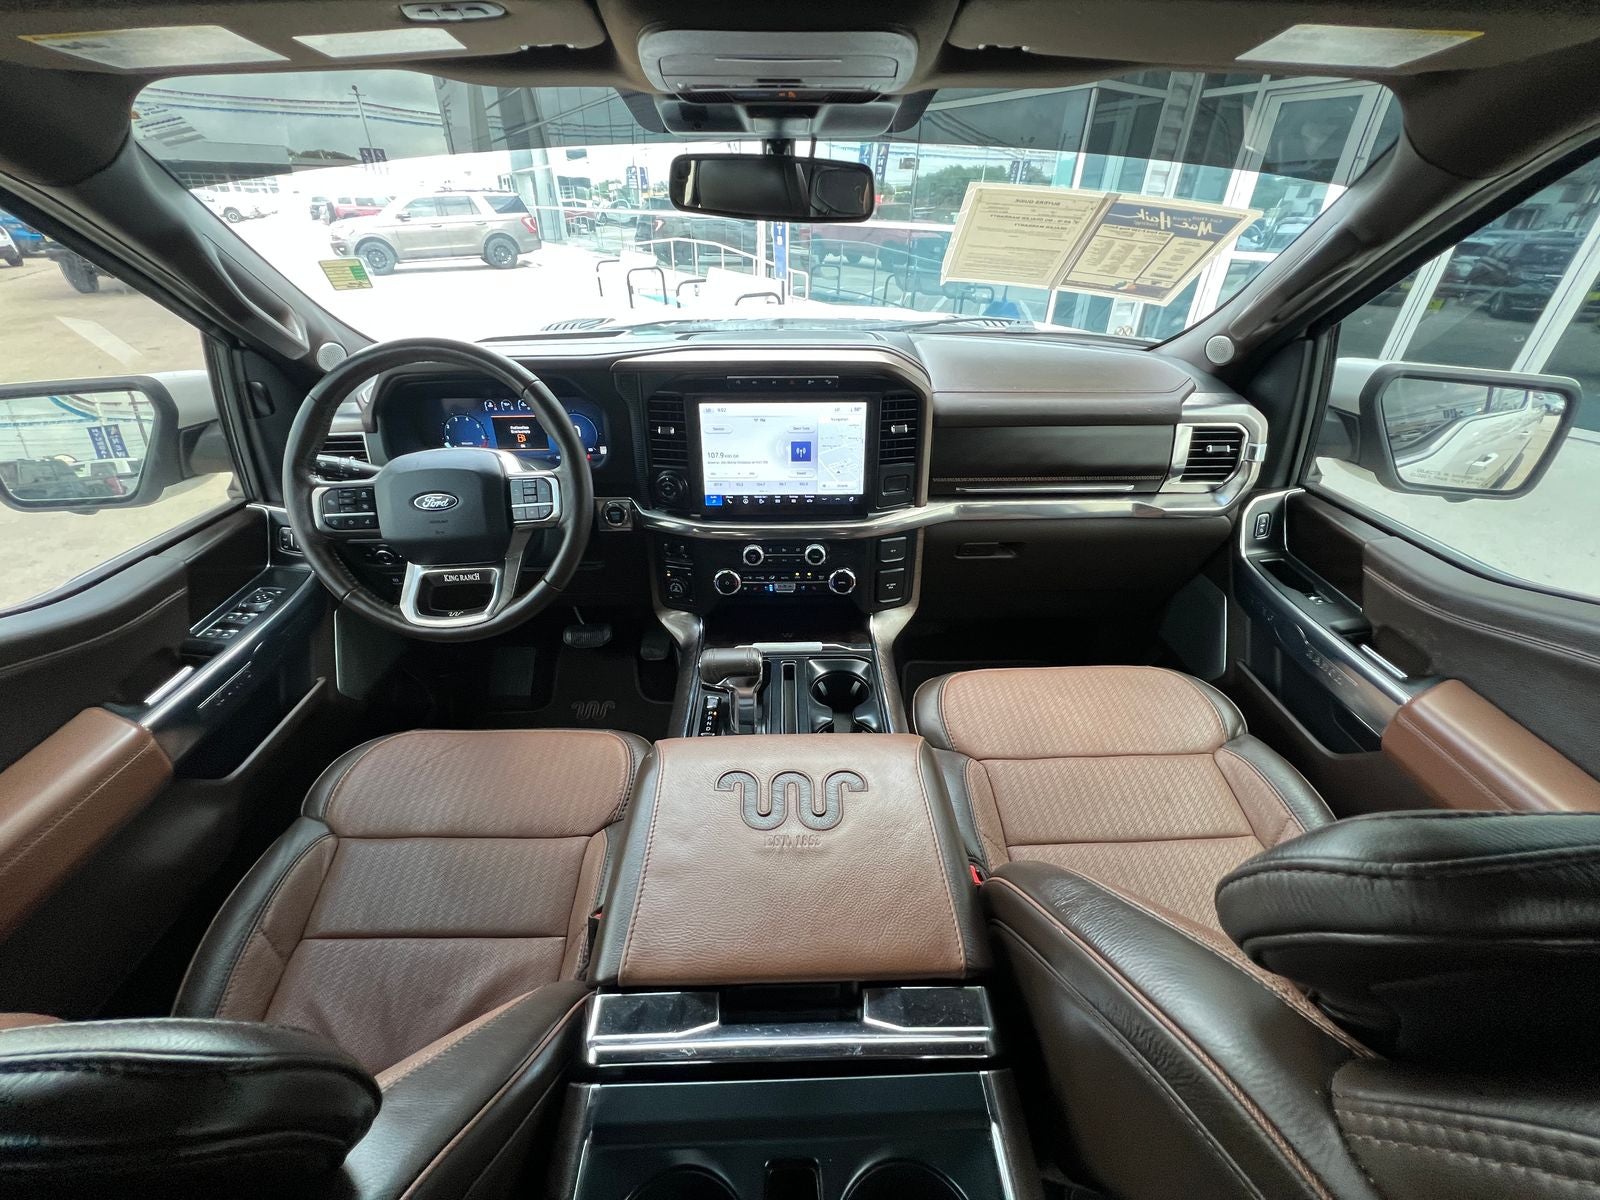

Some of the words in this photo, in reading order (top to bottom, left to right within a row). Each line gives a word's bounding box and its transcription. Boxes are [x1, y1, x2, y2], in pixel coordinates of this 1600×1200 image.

[422, 496, 449, 508] Ford
[443, 574, 460, 582] KING
[460, 572, 481, 582] RANCH
